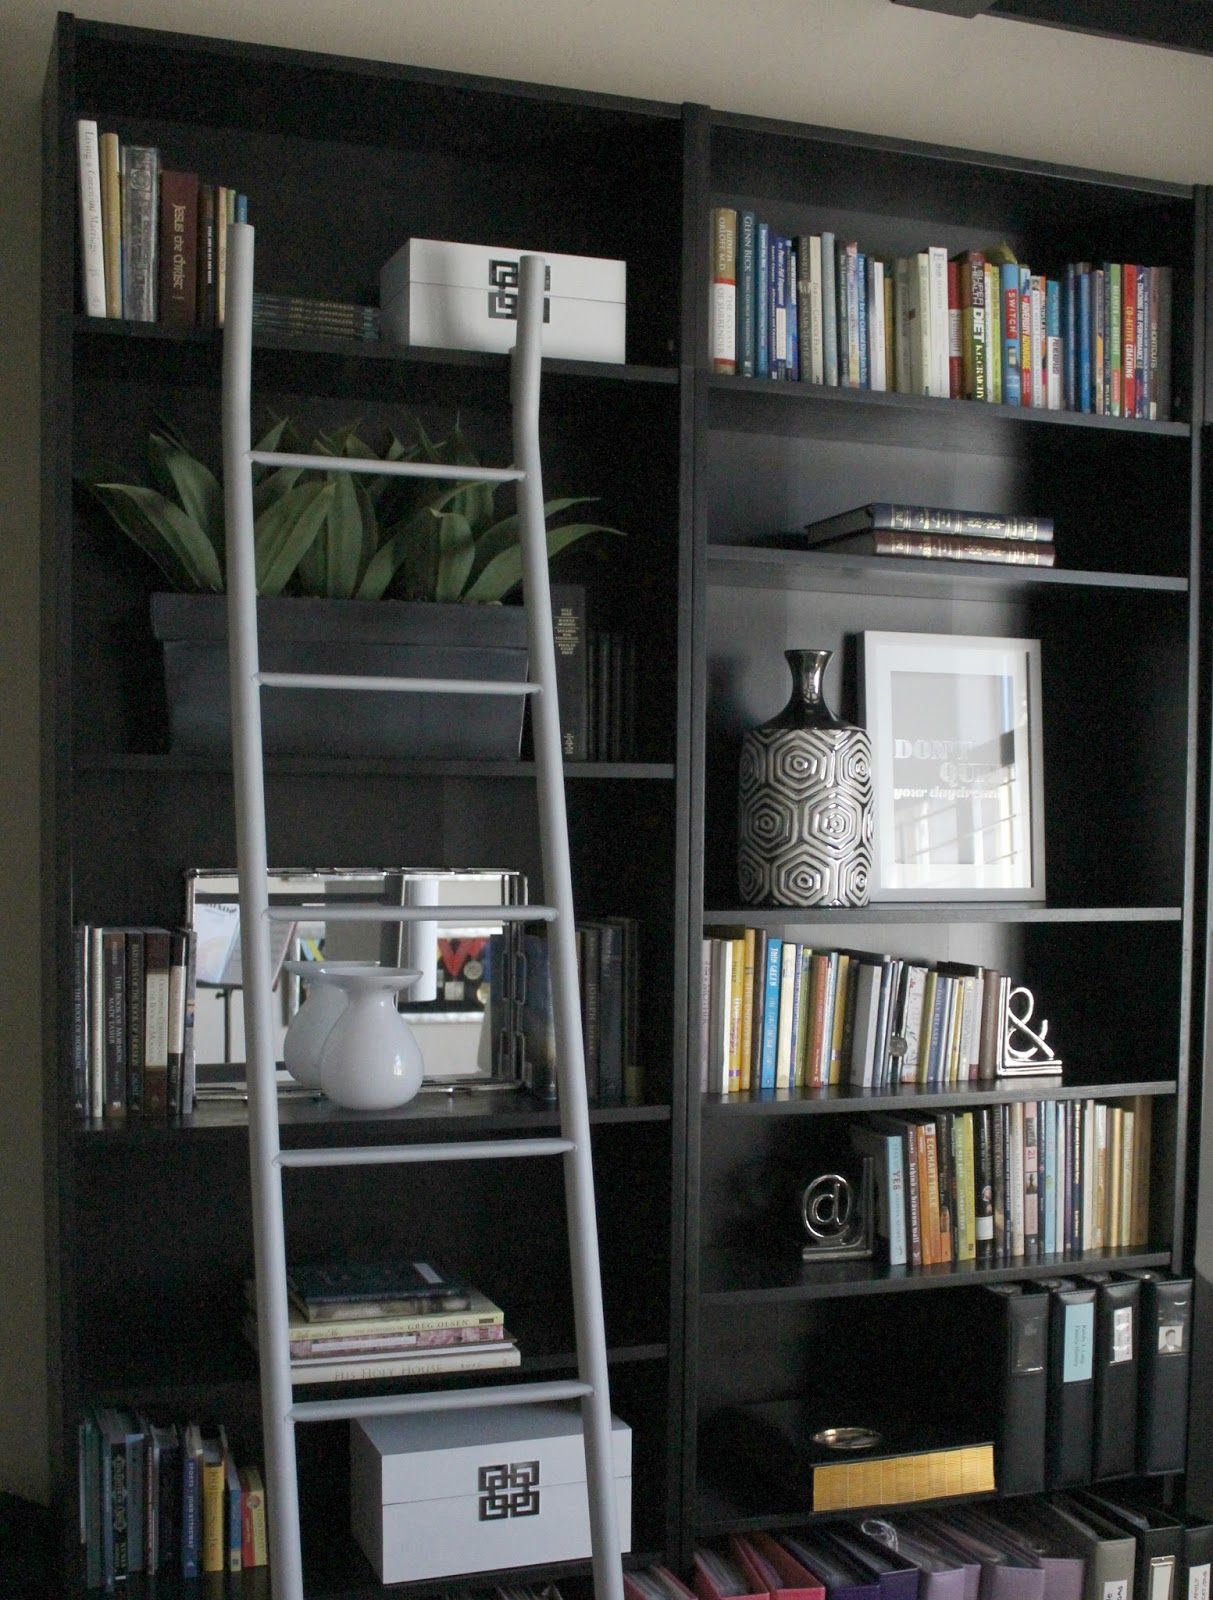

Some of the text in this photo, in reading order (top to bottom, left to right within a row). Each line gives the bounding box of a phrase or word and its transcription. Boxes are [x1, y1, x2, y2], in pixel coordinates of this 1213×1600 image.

[173, 203, 186, 233] Jesus
[743, 216, 752, 247] GLENN
[743, 249, 752, 272] BECK
[1008, 292, 1017, 333] SWITCH
[1022, 302, 1030, 335] ADVERSITY
[973, 308, 984, 343] DIET
[1023, 335, 1031, 370] ADVANTAGE
[1125, 306, 1133, 379] CO-ACTIVE COACHING
[893, 788, 928, 800] your
[770, 947, 778, 963] JOHN
[770, 965, 778, 986] GREEN
[115, 1015, 122, 1025] OF
[932, 989, 943, 1046] DAILY RELAXER
[994, 1143, 1001, 1152] OF
[1027, 1150, 1036, 1161] 21
[893, 1170, 901, 1191] YES
[927, 1138, 936, 1208] ECKHART TOLLE
[407, 1319, 469, 1331] GREG OLSEN
[362, 1368, 393, 1379] HOLY
[402, 1365, 442, 1376] HOUSE
